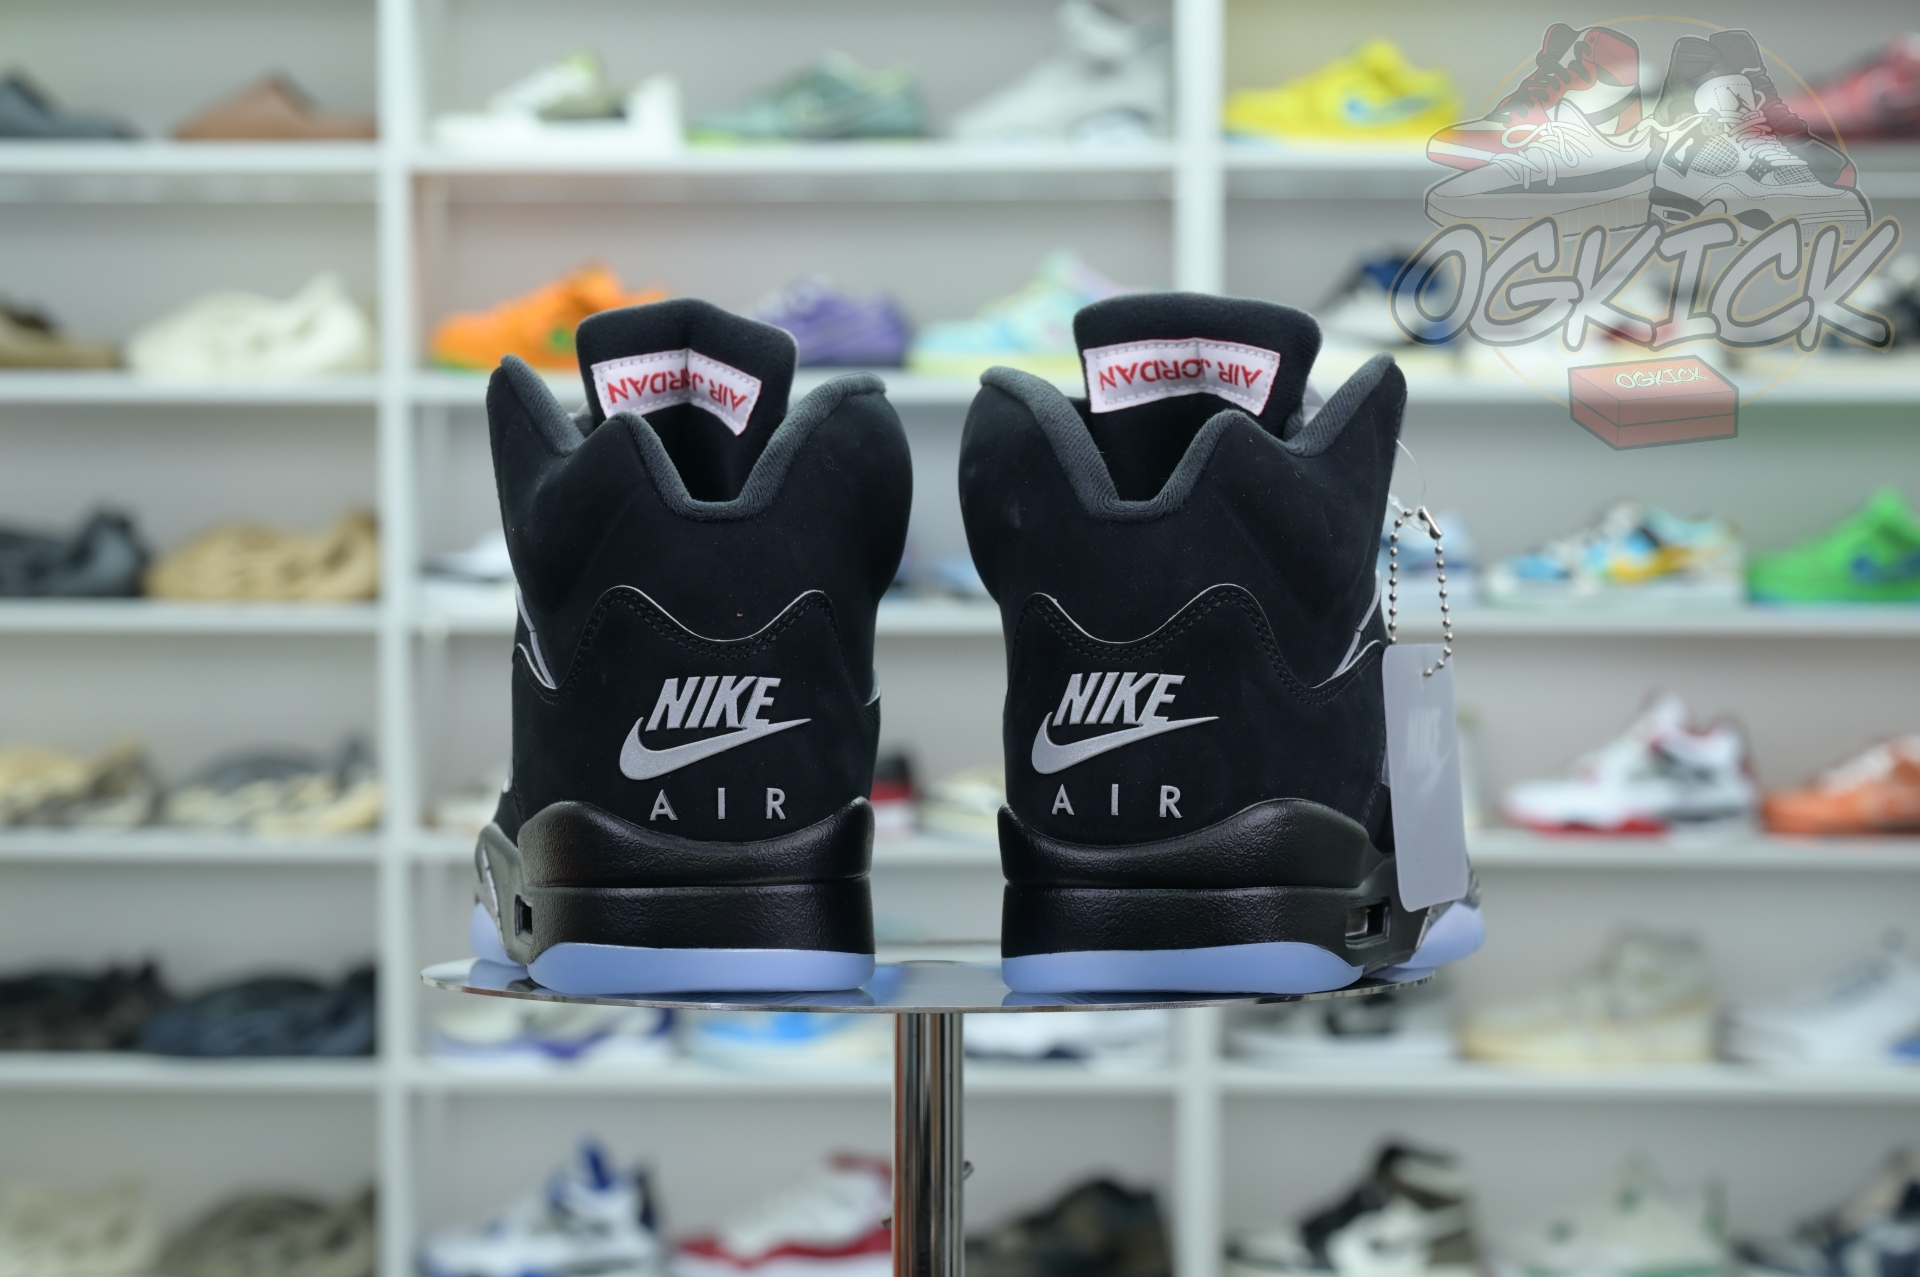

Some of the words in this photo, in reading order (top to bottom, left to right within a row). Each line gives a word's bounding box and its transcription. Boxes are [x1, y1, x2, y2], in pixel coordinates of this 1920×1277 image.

[607, 368, 704, 404] JRDAN
[1100, 358, 1211, 391] JORDAN
[1217, 361, 1263, 389] AIR
[709, 378, 748, 411] AIR
[645, 675, 781, 732] NIKE
[1052, 671, 1186, 727] NIKE
[650, 787, 786, 821] AIR
[1051, 783, 1183, 819] AIR
